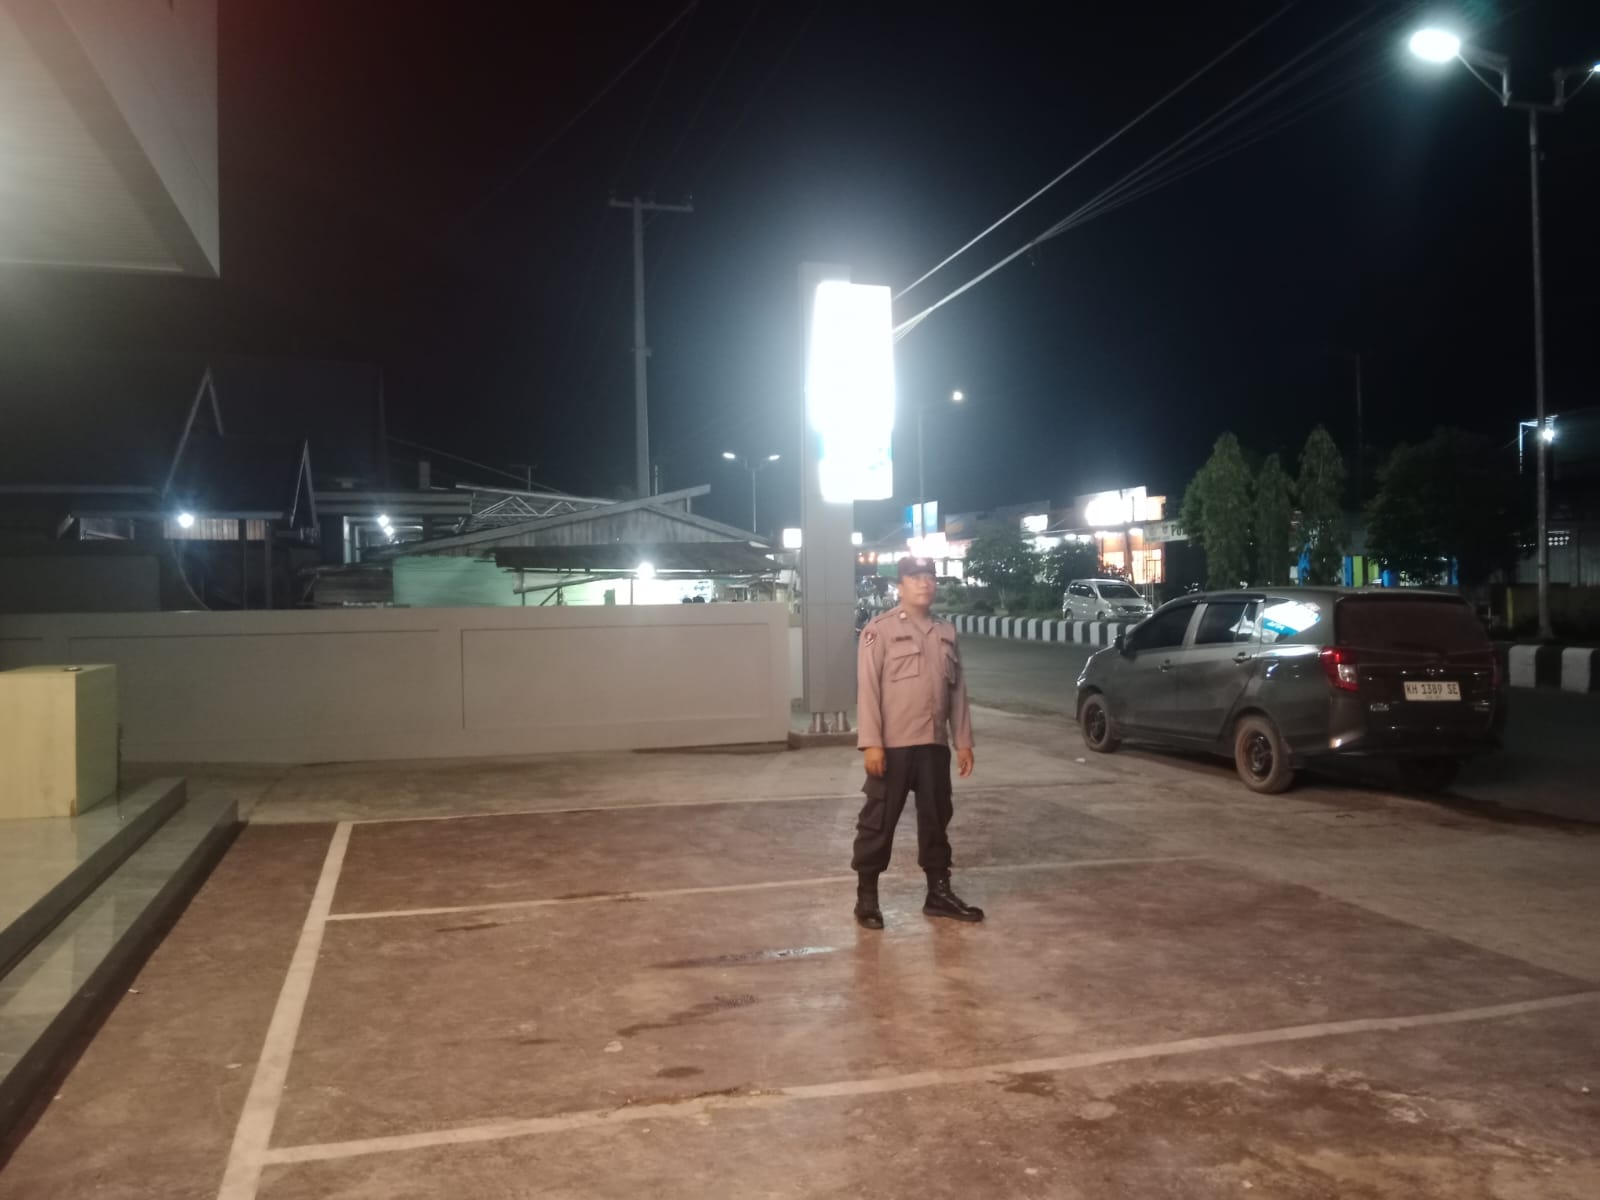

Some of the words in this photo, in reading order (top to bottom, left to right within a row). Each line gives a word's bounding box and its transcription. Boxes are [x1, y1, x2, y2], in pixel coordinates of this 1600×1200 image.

[1406, 683, 1418, 694] KH
[1421, 683, 1443, 695] 1389
[1447, 683, 1459, 695] SE
